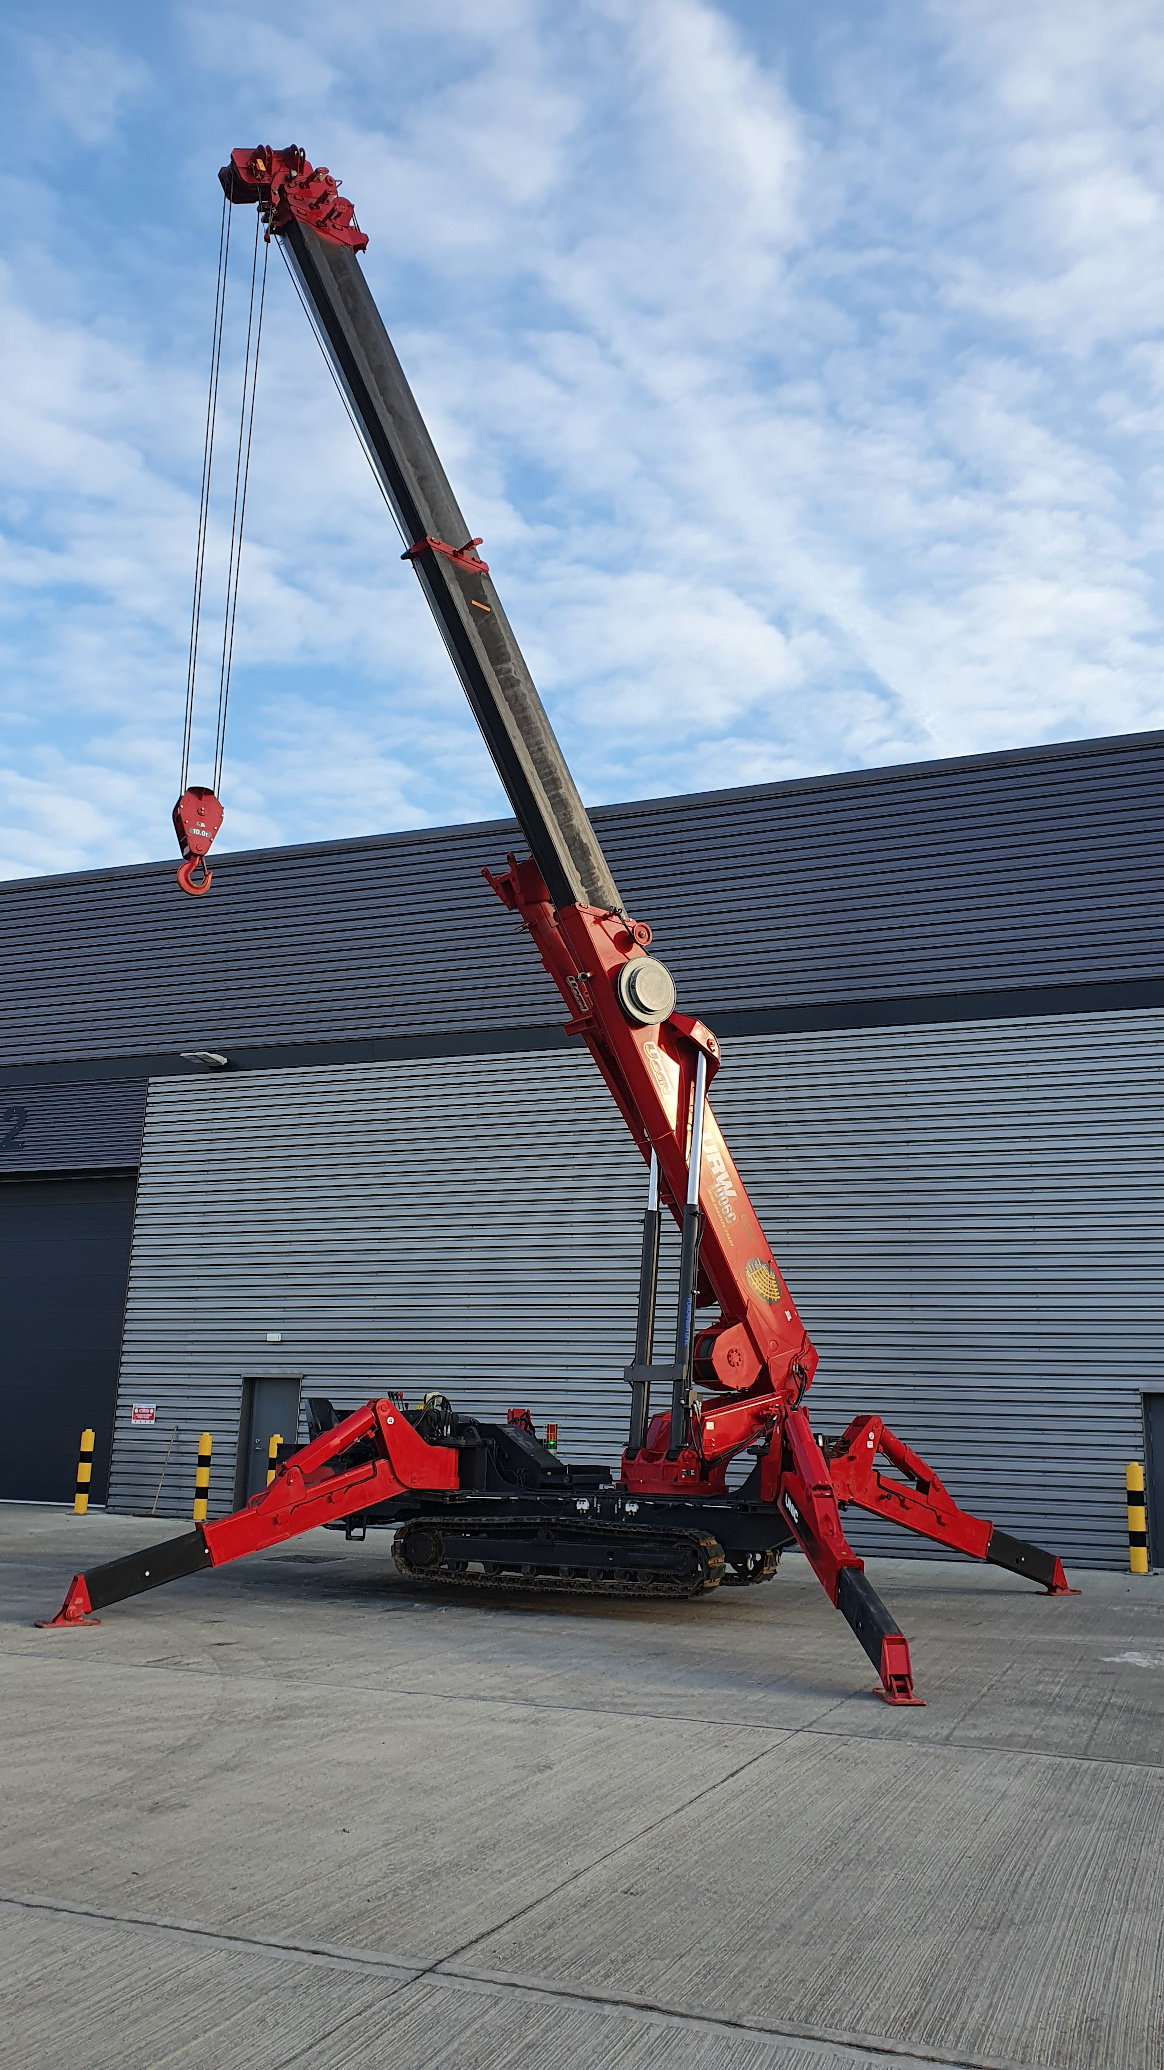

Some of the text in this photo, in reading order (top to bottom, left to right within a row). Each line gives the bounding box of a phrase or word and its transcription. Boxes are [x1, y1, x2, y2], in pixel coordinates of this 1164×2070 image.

[0, 1106, 26, 1149] 2
[702, 1131, 738, 1199] URW
[712, 1182, 737, 1225] 1006C
